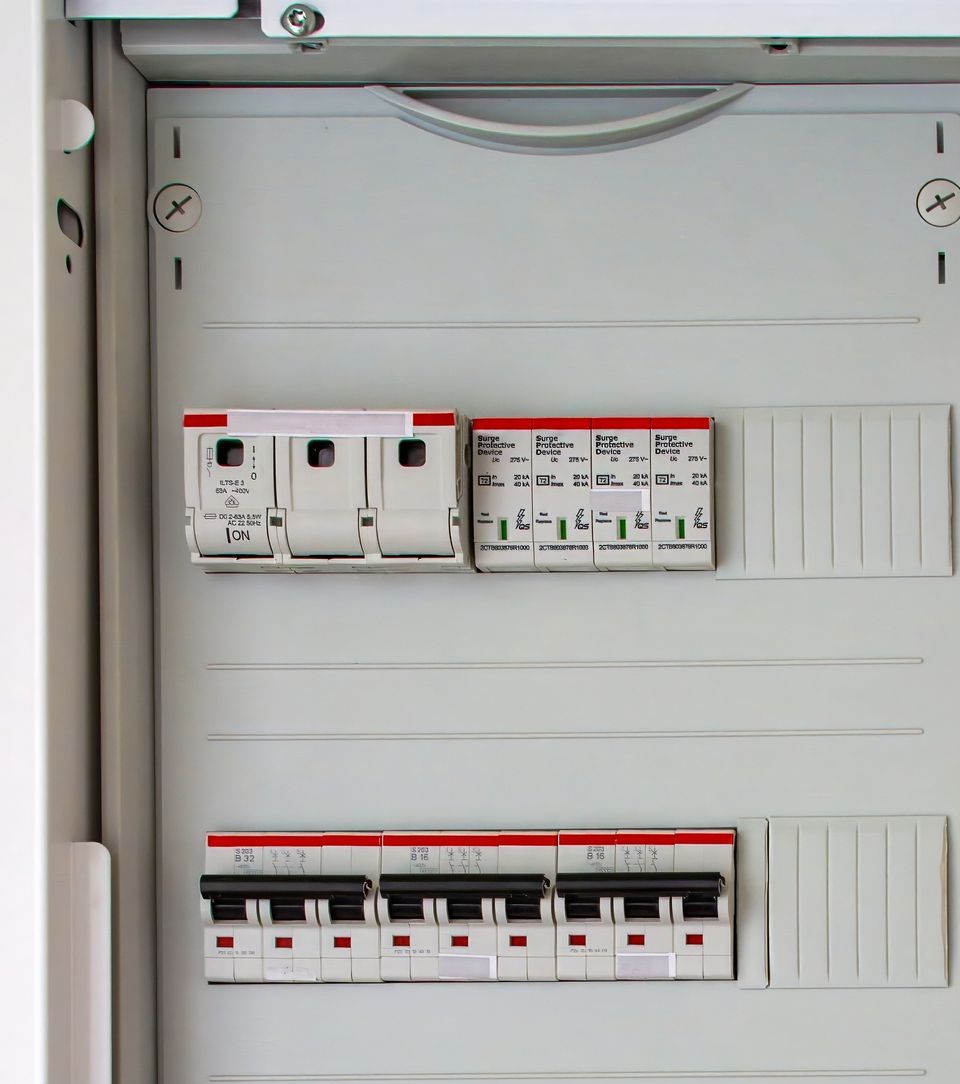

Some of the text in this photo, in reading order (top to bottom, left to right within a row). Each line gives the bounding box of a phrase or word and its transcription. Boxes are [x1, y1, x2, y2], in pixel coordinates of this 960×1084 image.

[595, 434, 618, 442] Surge
[655, 447, 680, 455] Device
[232, 530, 250, 541] ON
